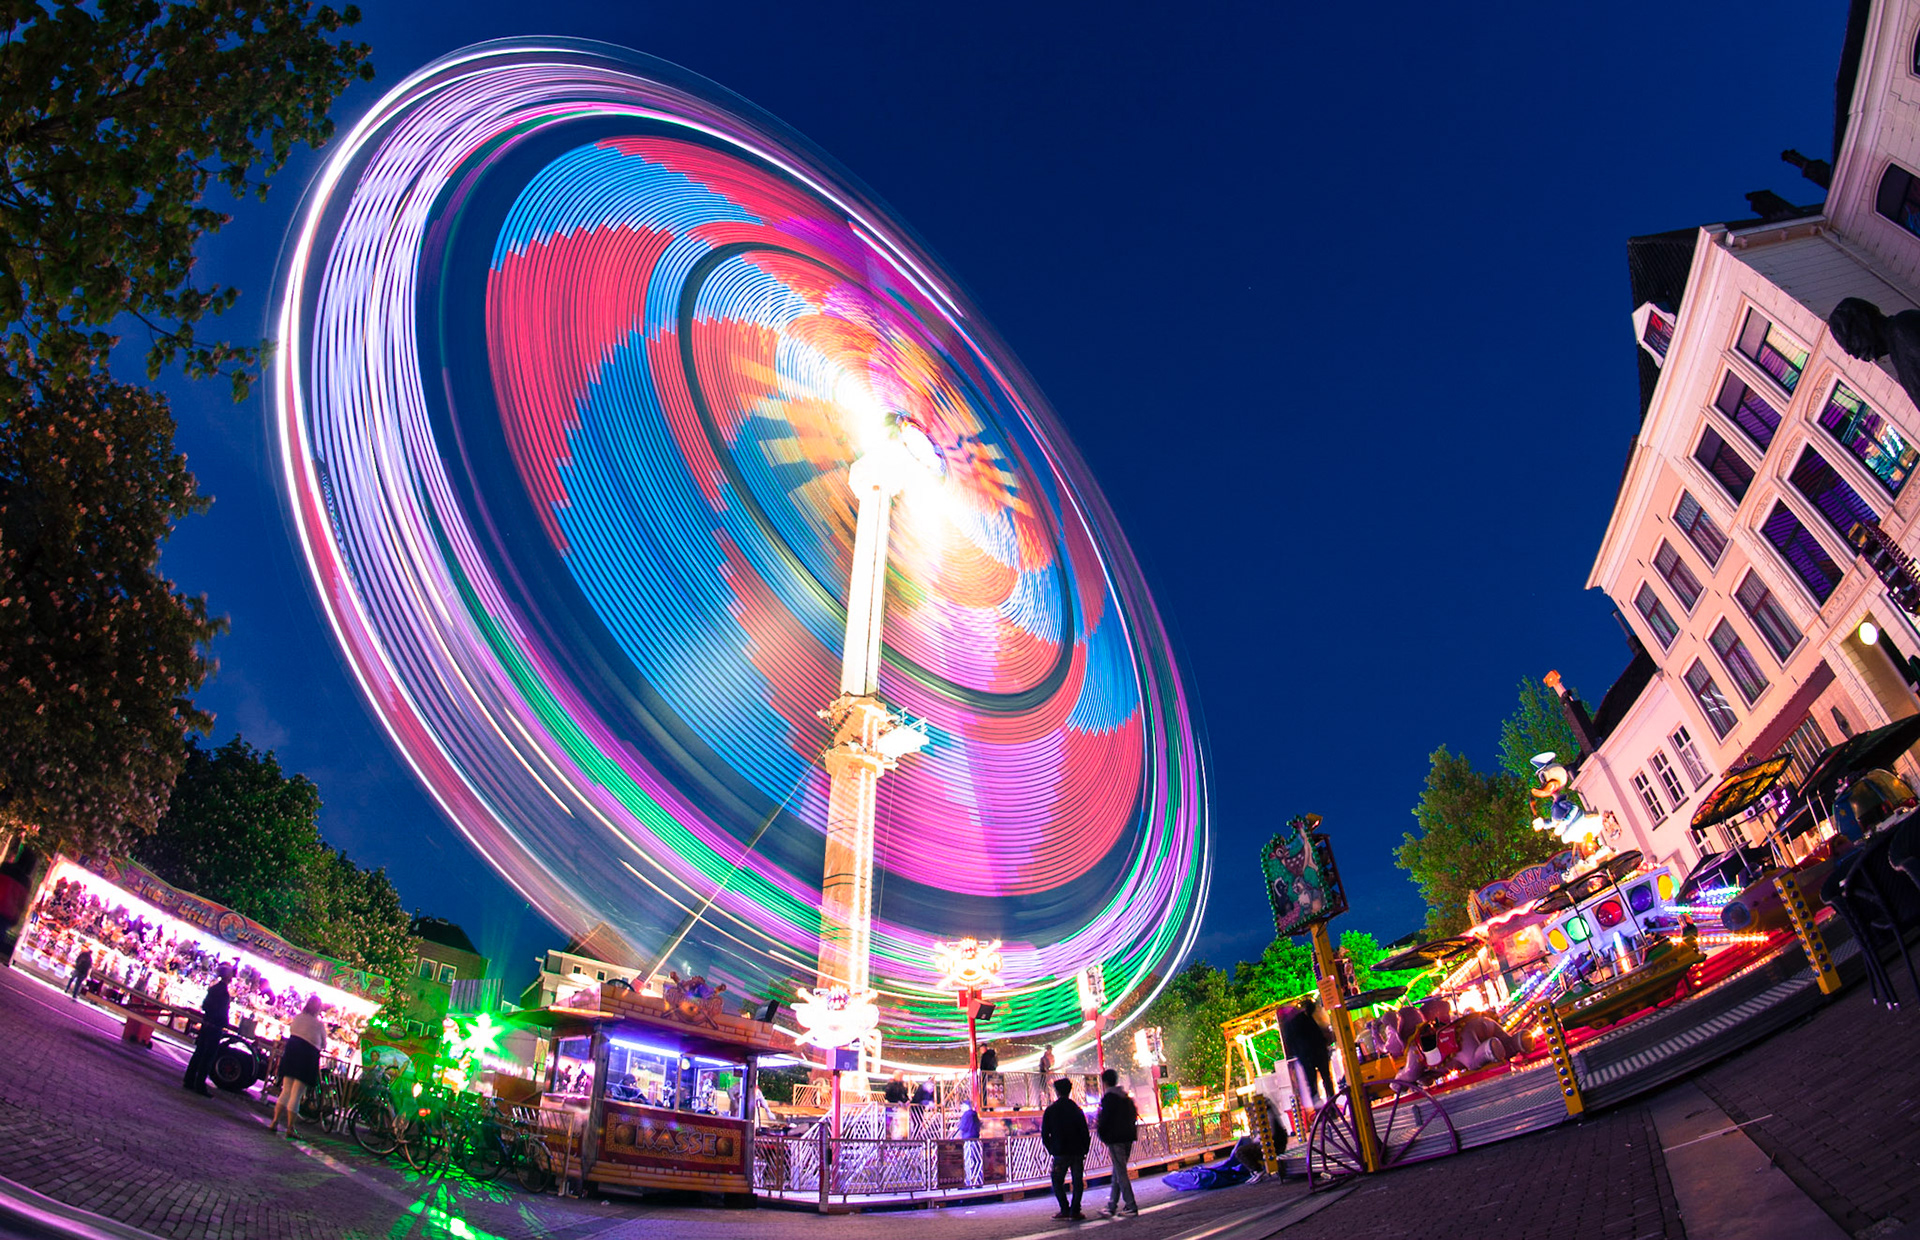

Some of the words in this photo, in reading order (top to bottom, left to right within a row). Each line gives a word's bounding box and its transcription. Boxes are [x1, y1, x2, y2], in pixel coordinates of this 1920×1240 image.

[1506, 867, 1542, 900] FUNNY
[1524, 872, 1561, 898] FLIGHT
[635, 1125, 716, 1156] KASSE
